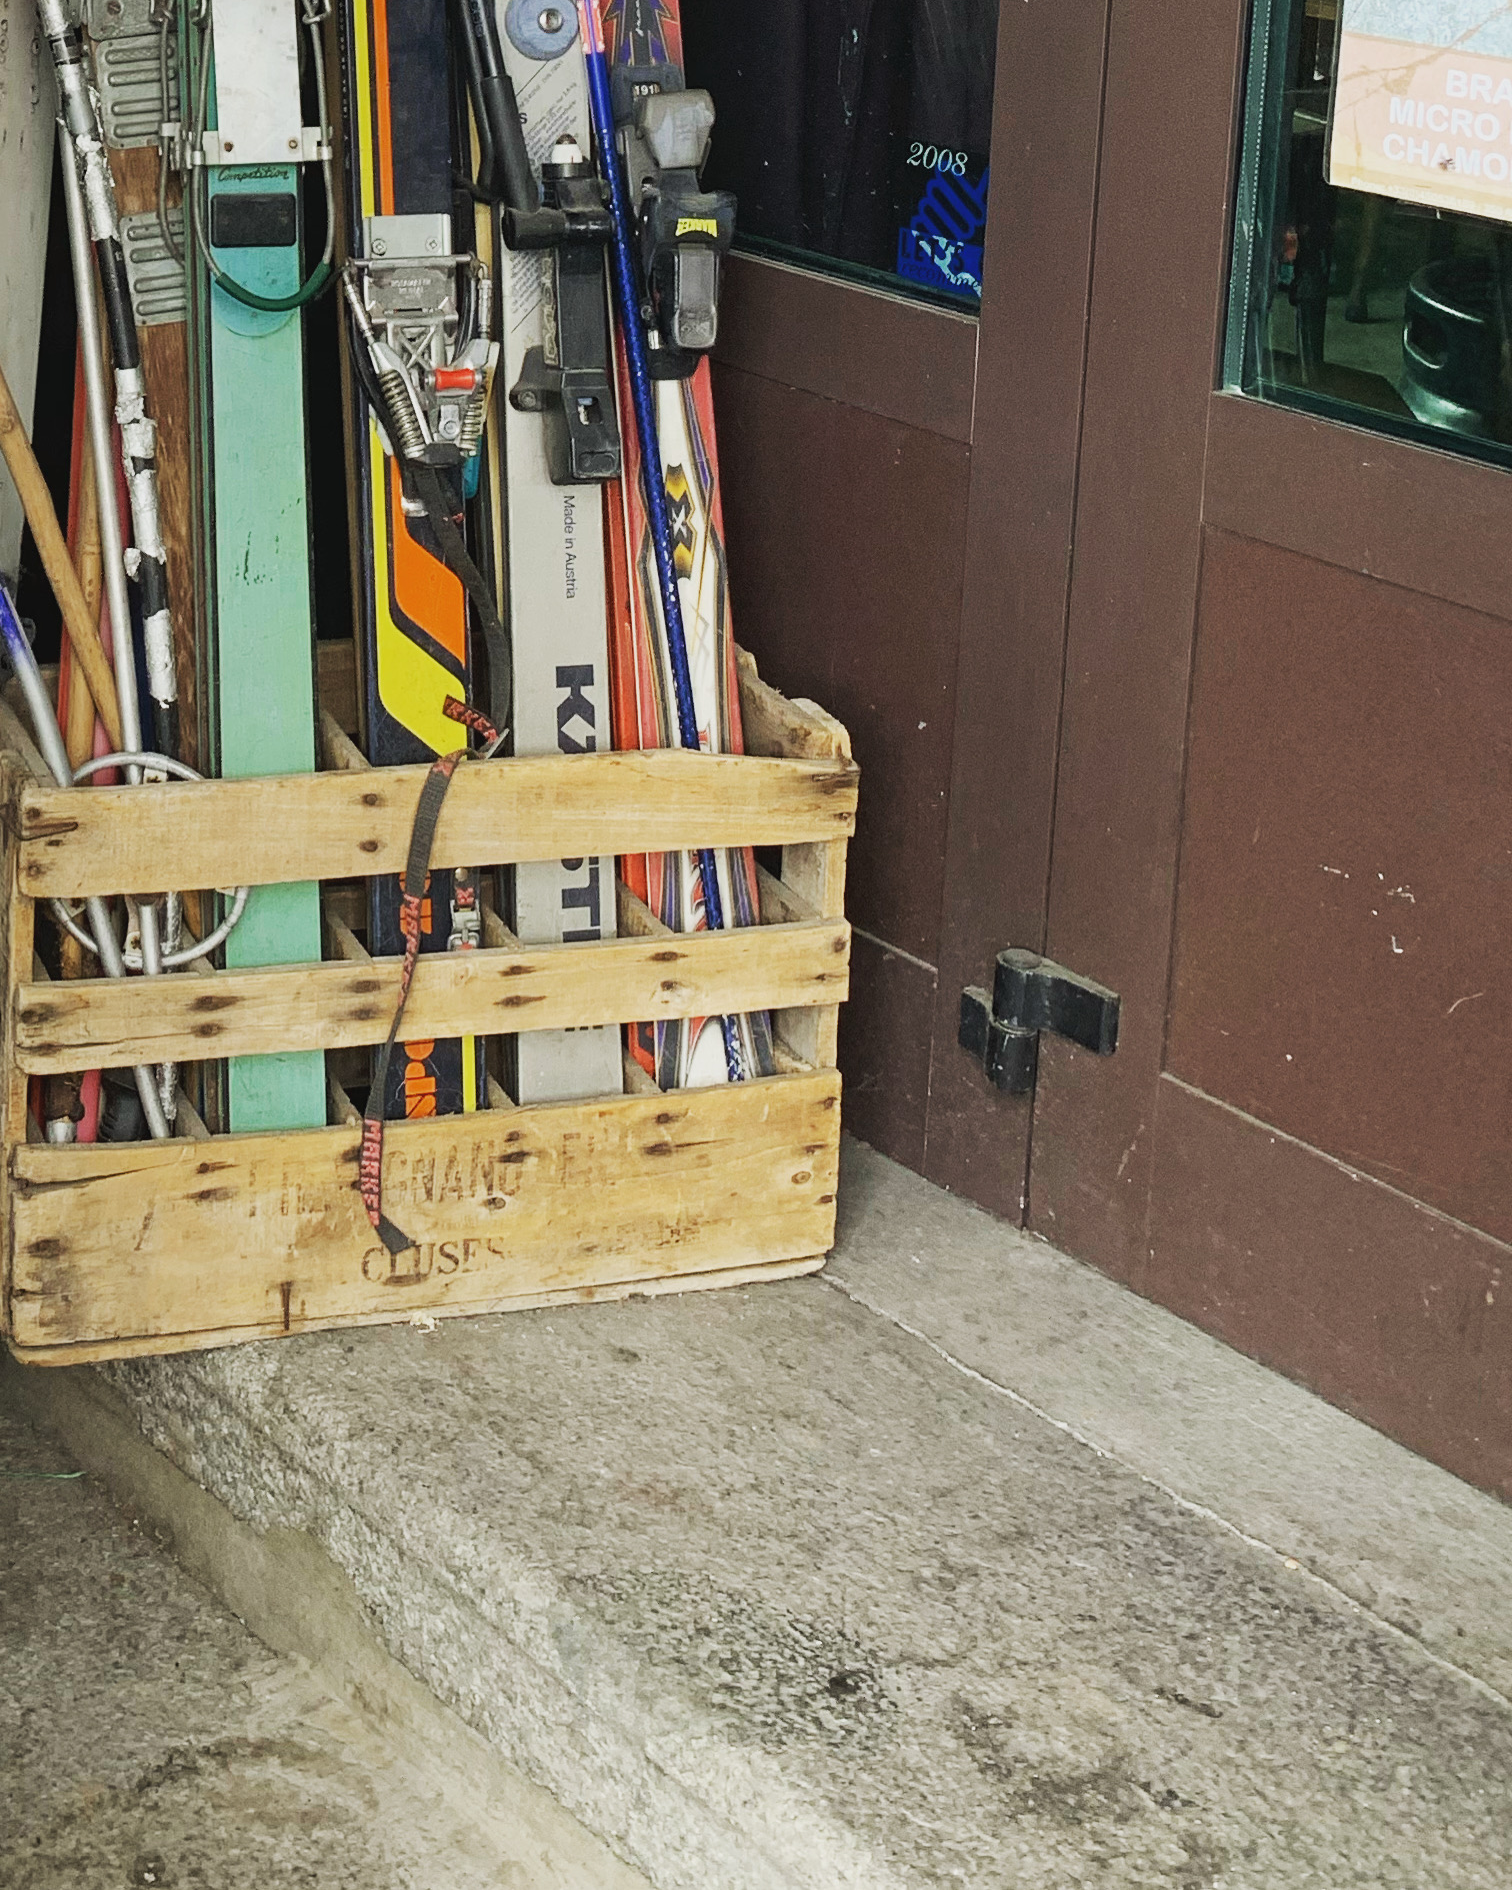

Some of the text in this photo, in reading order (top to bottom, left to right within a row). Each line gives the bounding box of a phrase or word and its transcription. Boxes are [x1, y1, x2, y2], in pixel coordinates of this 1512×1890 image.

[1389, 96, 1501, 143] MICRO
[217, 164, 291, 183] Competition
[906, 141, 969, 177] 2008
[1382, 133, 1508, 182] CHAMO
[561, 494, 578, 531] Made
[562, 547, 578, 601] Austria
